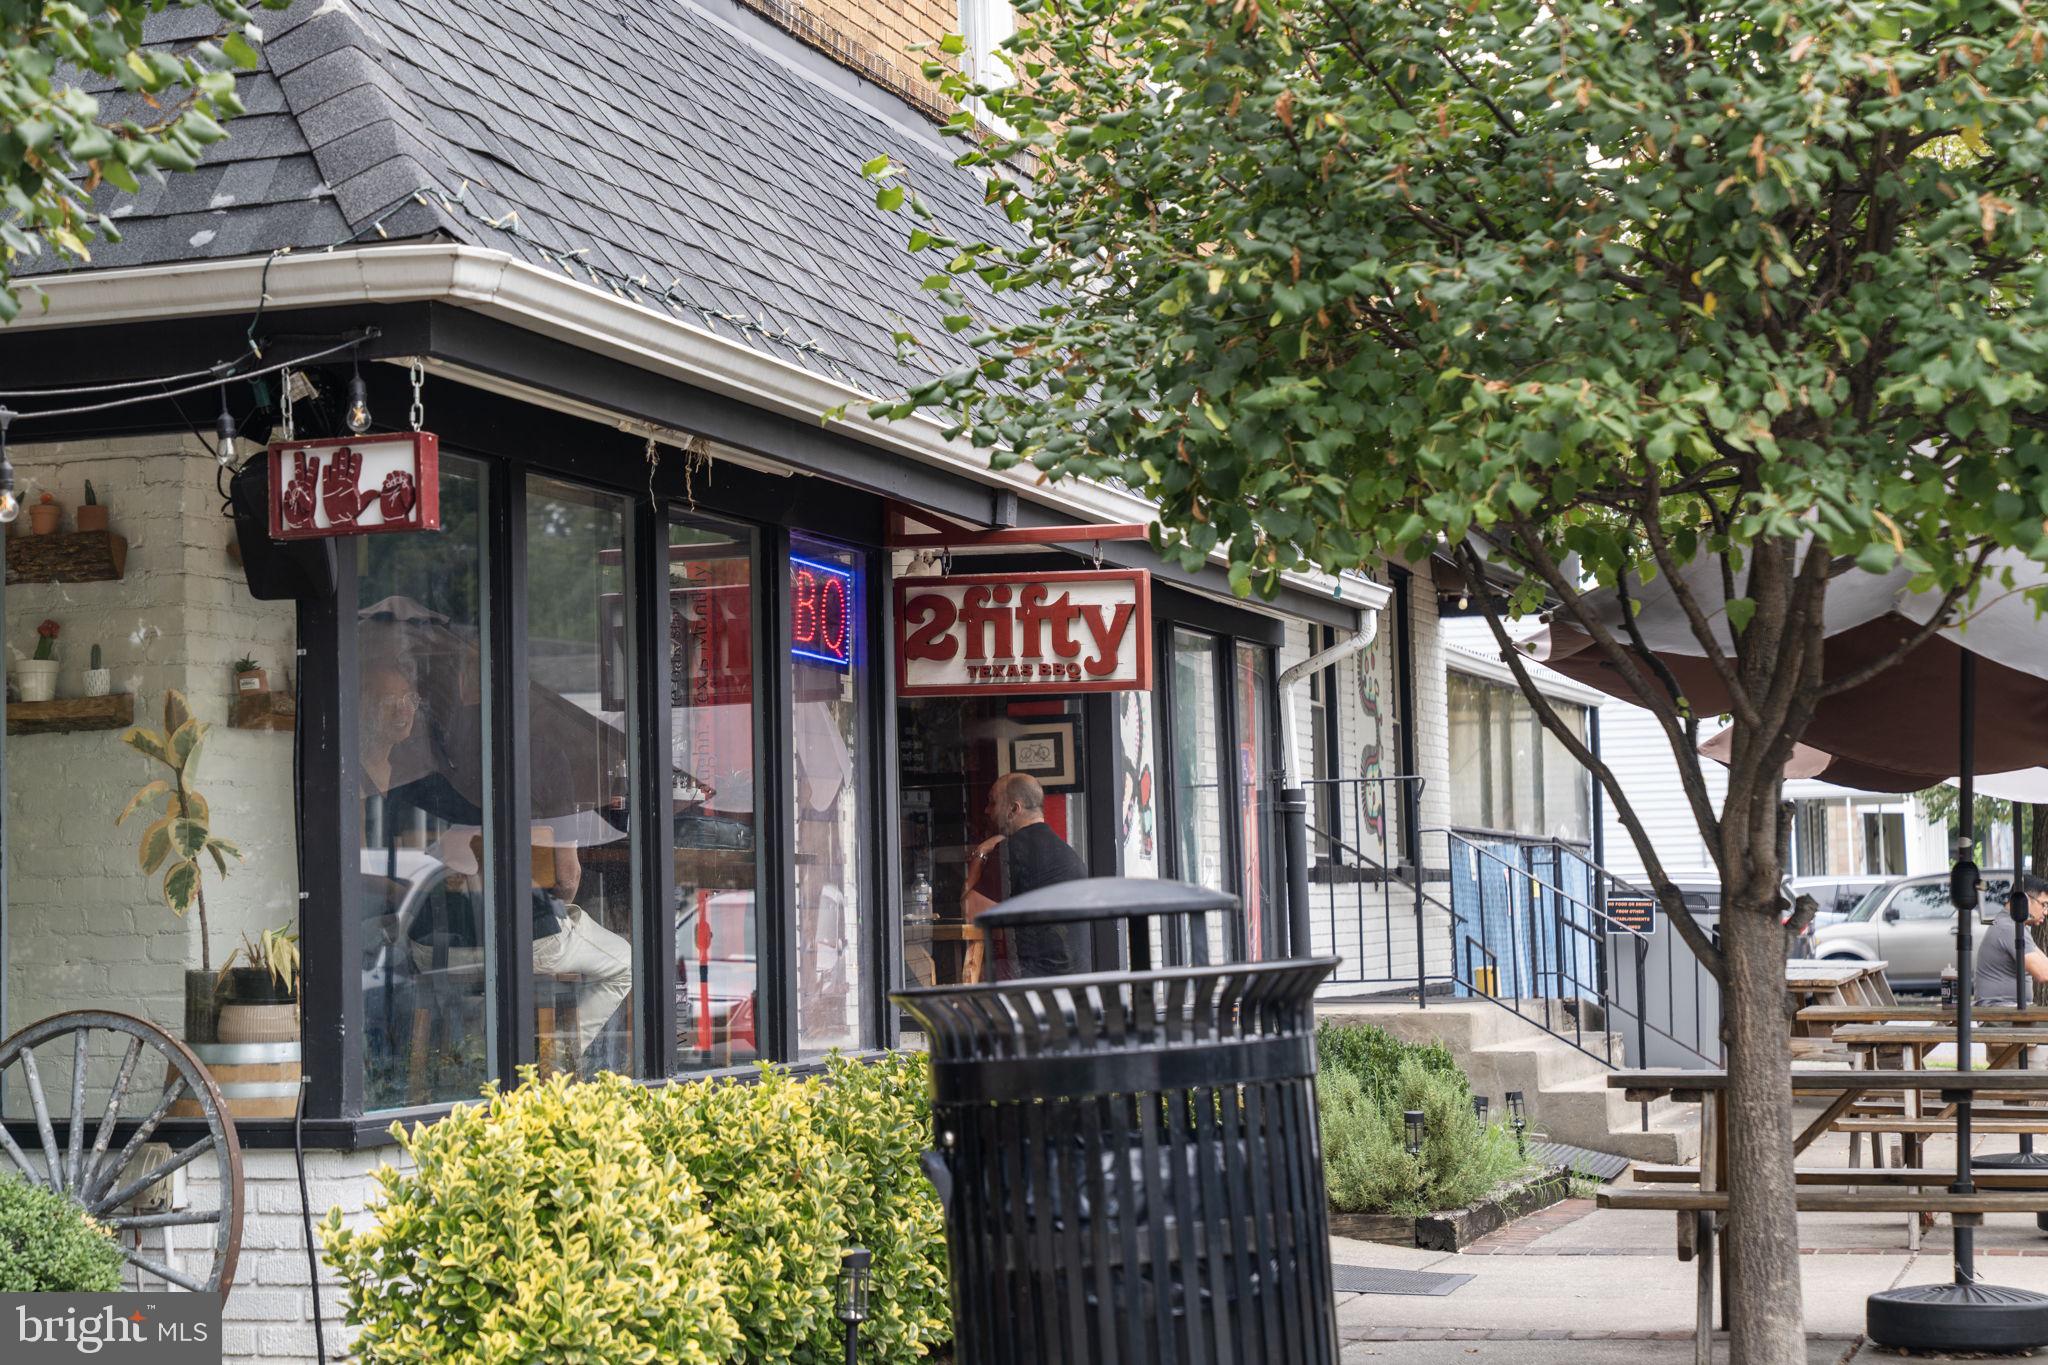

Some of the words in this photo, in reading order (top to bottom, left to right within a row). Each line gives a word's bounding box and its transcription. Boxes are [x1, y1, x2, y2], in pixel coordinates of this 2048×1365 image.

[688, 564, 713, 651] Monthly
[796, 569, 846, 658] BQ
[905, 583, 1136, 677] 2fifty
[966, 664, 1033, 680] TEXAS
[1038, 663, 1081, 680] BBQ
